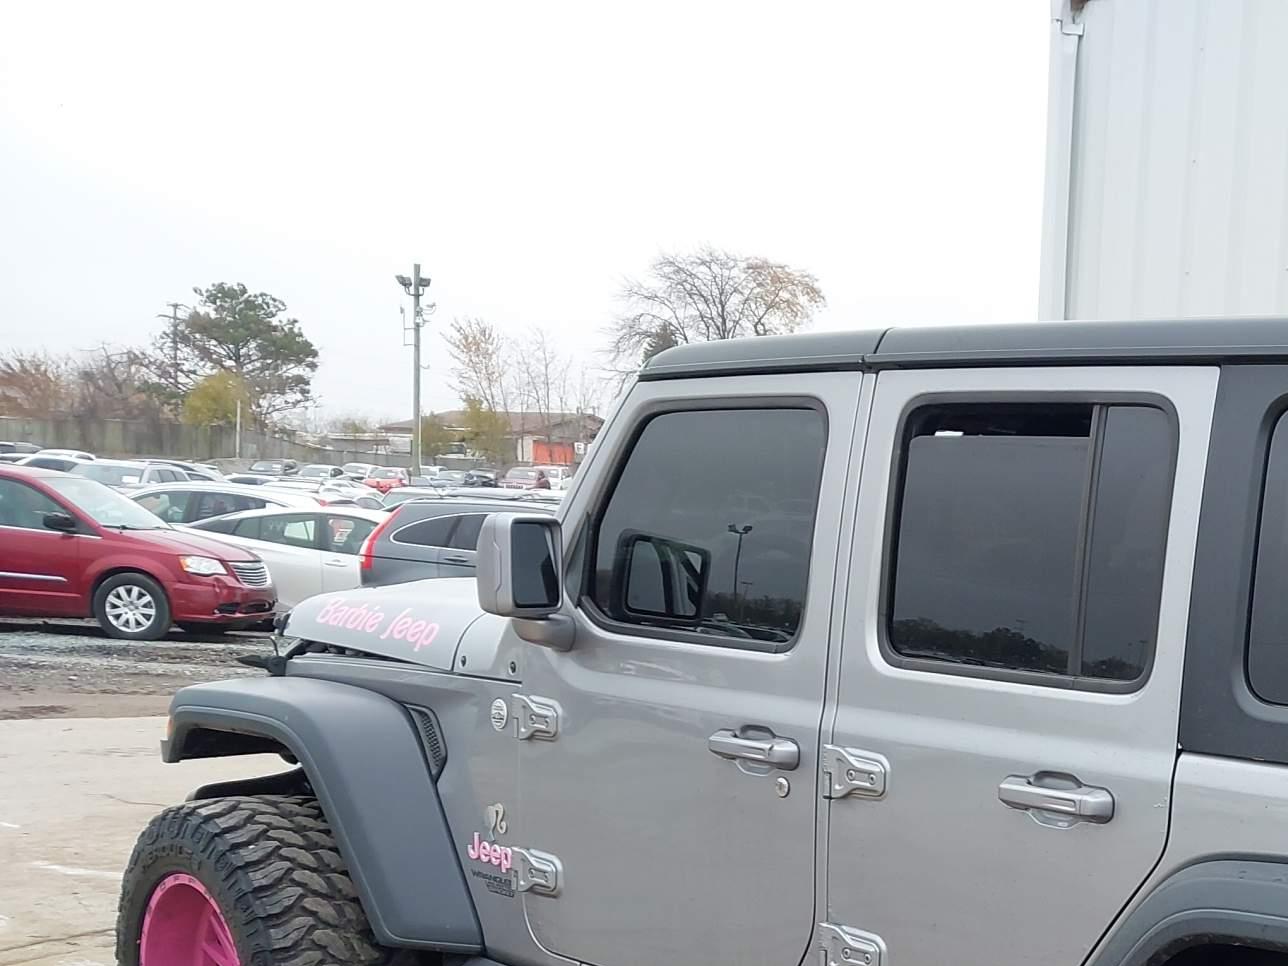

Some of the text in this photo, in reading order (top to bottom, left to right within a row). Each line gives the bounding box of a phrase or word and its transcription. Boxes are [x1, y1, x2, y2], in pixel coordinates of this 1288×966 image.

[316, 599, 440, 651] Barbie Jeep
[467, 832, 512, 873] Jeep
